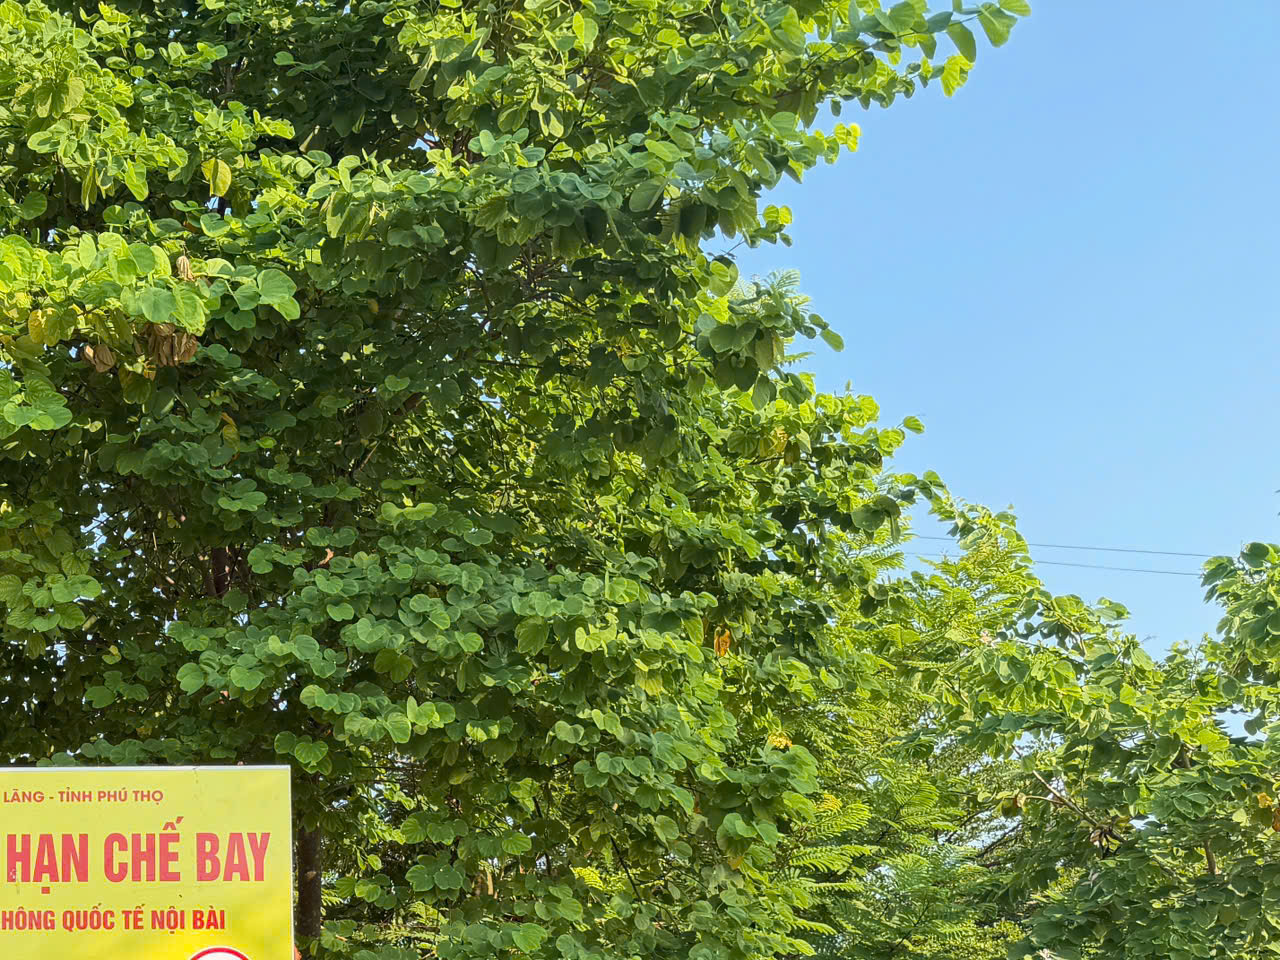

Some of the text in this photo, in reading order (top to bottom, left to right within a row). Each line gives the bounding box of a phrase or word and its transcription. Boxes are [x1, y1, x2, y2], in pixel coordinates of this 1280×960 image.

[58, 787, 92, 802] TỈNH
[97, 787, 128, 802] PHÚ
[132, 790, 164, 805] THỌ
[7, 833, 88, 895] HẠN
[104, 816, 184, 882] CHẾ
[196, 832, 271, 882] BAY
[63, 903, 115, 932] QUỐC
[121, 903, 145, 930] TẾ
[151, 905, 185, 934] NỘI
[192, 905, 225, 930] BÀI
